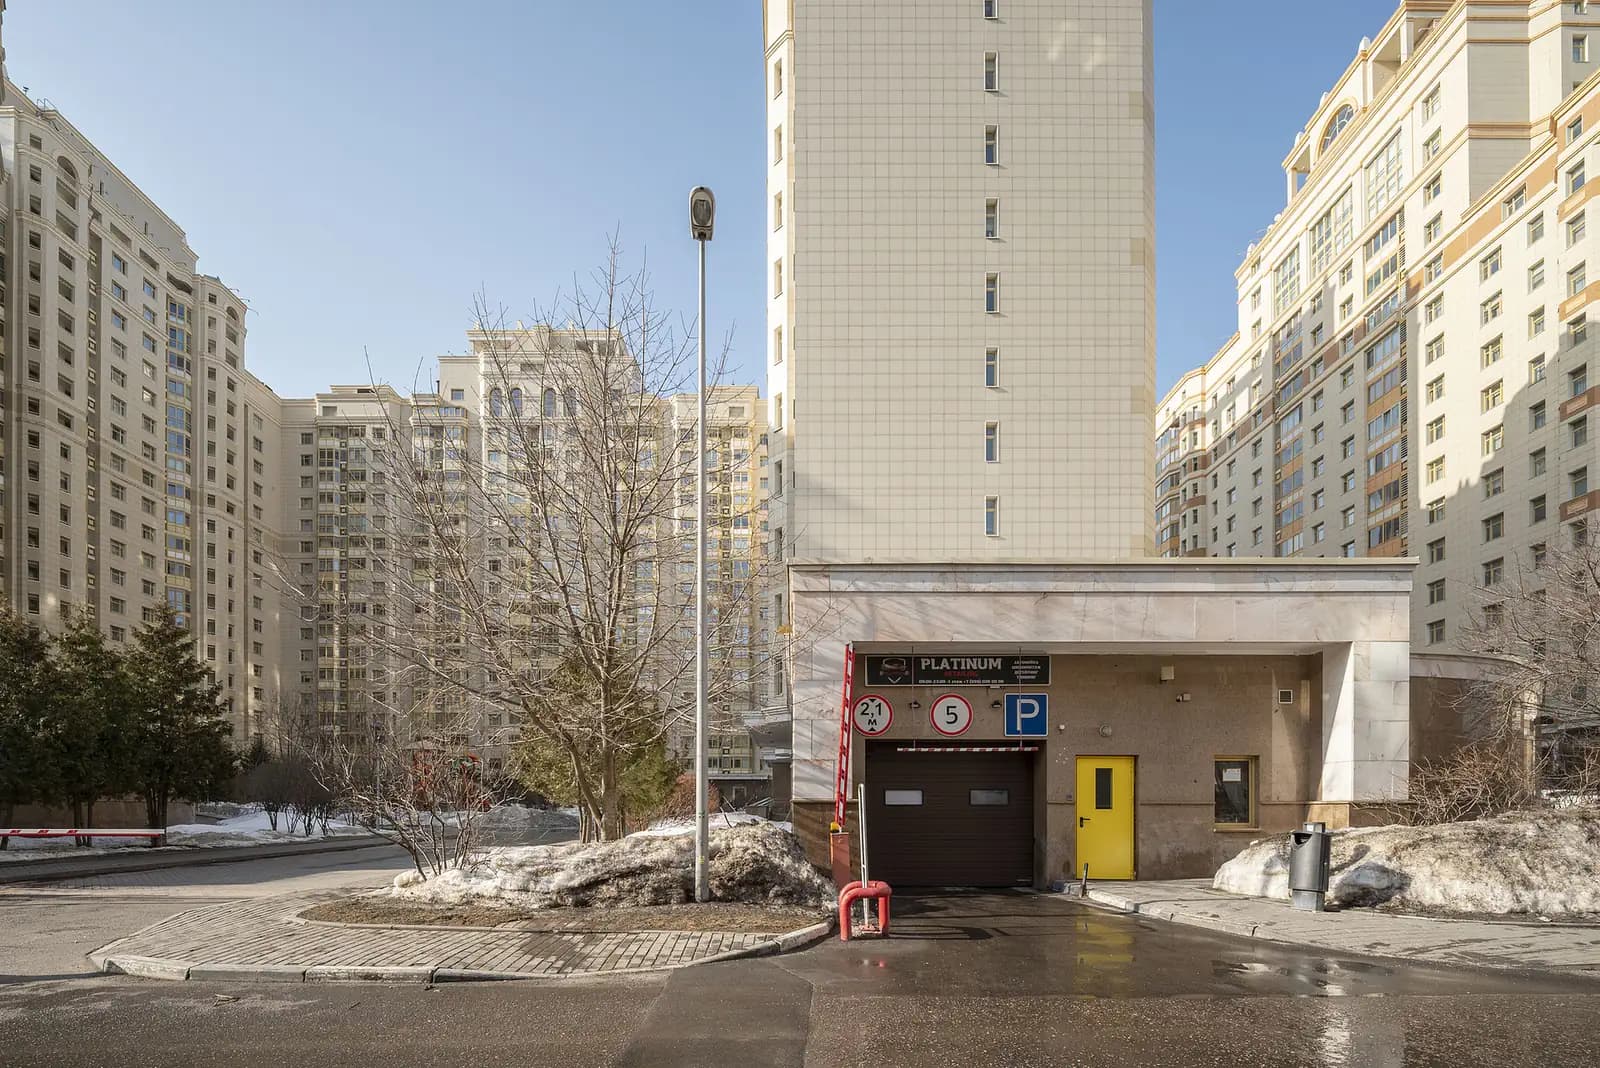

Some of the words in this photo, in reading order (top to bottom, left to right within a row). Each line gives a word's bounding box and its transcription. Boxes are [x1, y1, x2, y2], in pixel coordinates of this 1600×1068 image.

[920, 658, 1002, 670] PLATINUM
[860, 702, 882, 718] 2,1
[945, 705, 958, 724] 5
[1016, 698, 1040, 731] P
